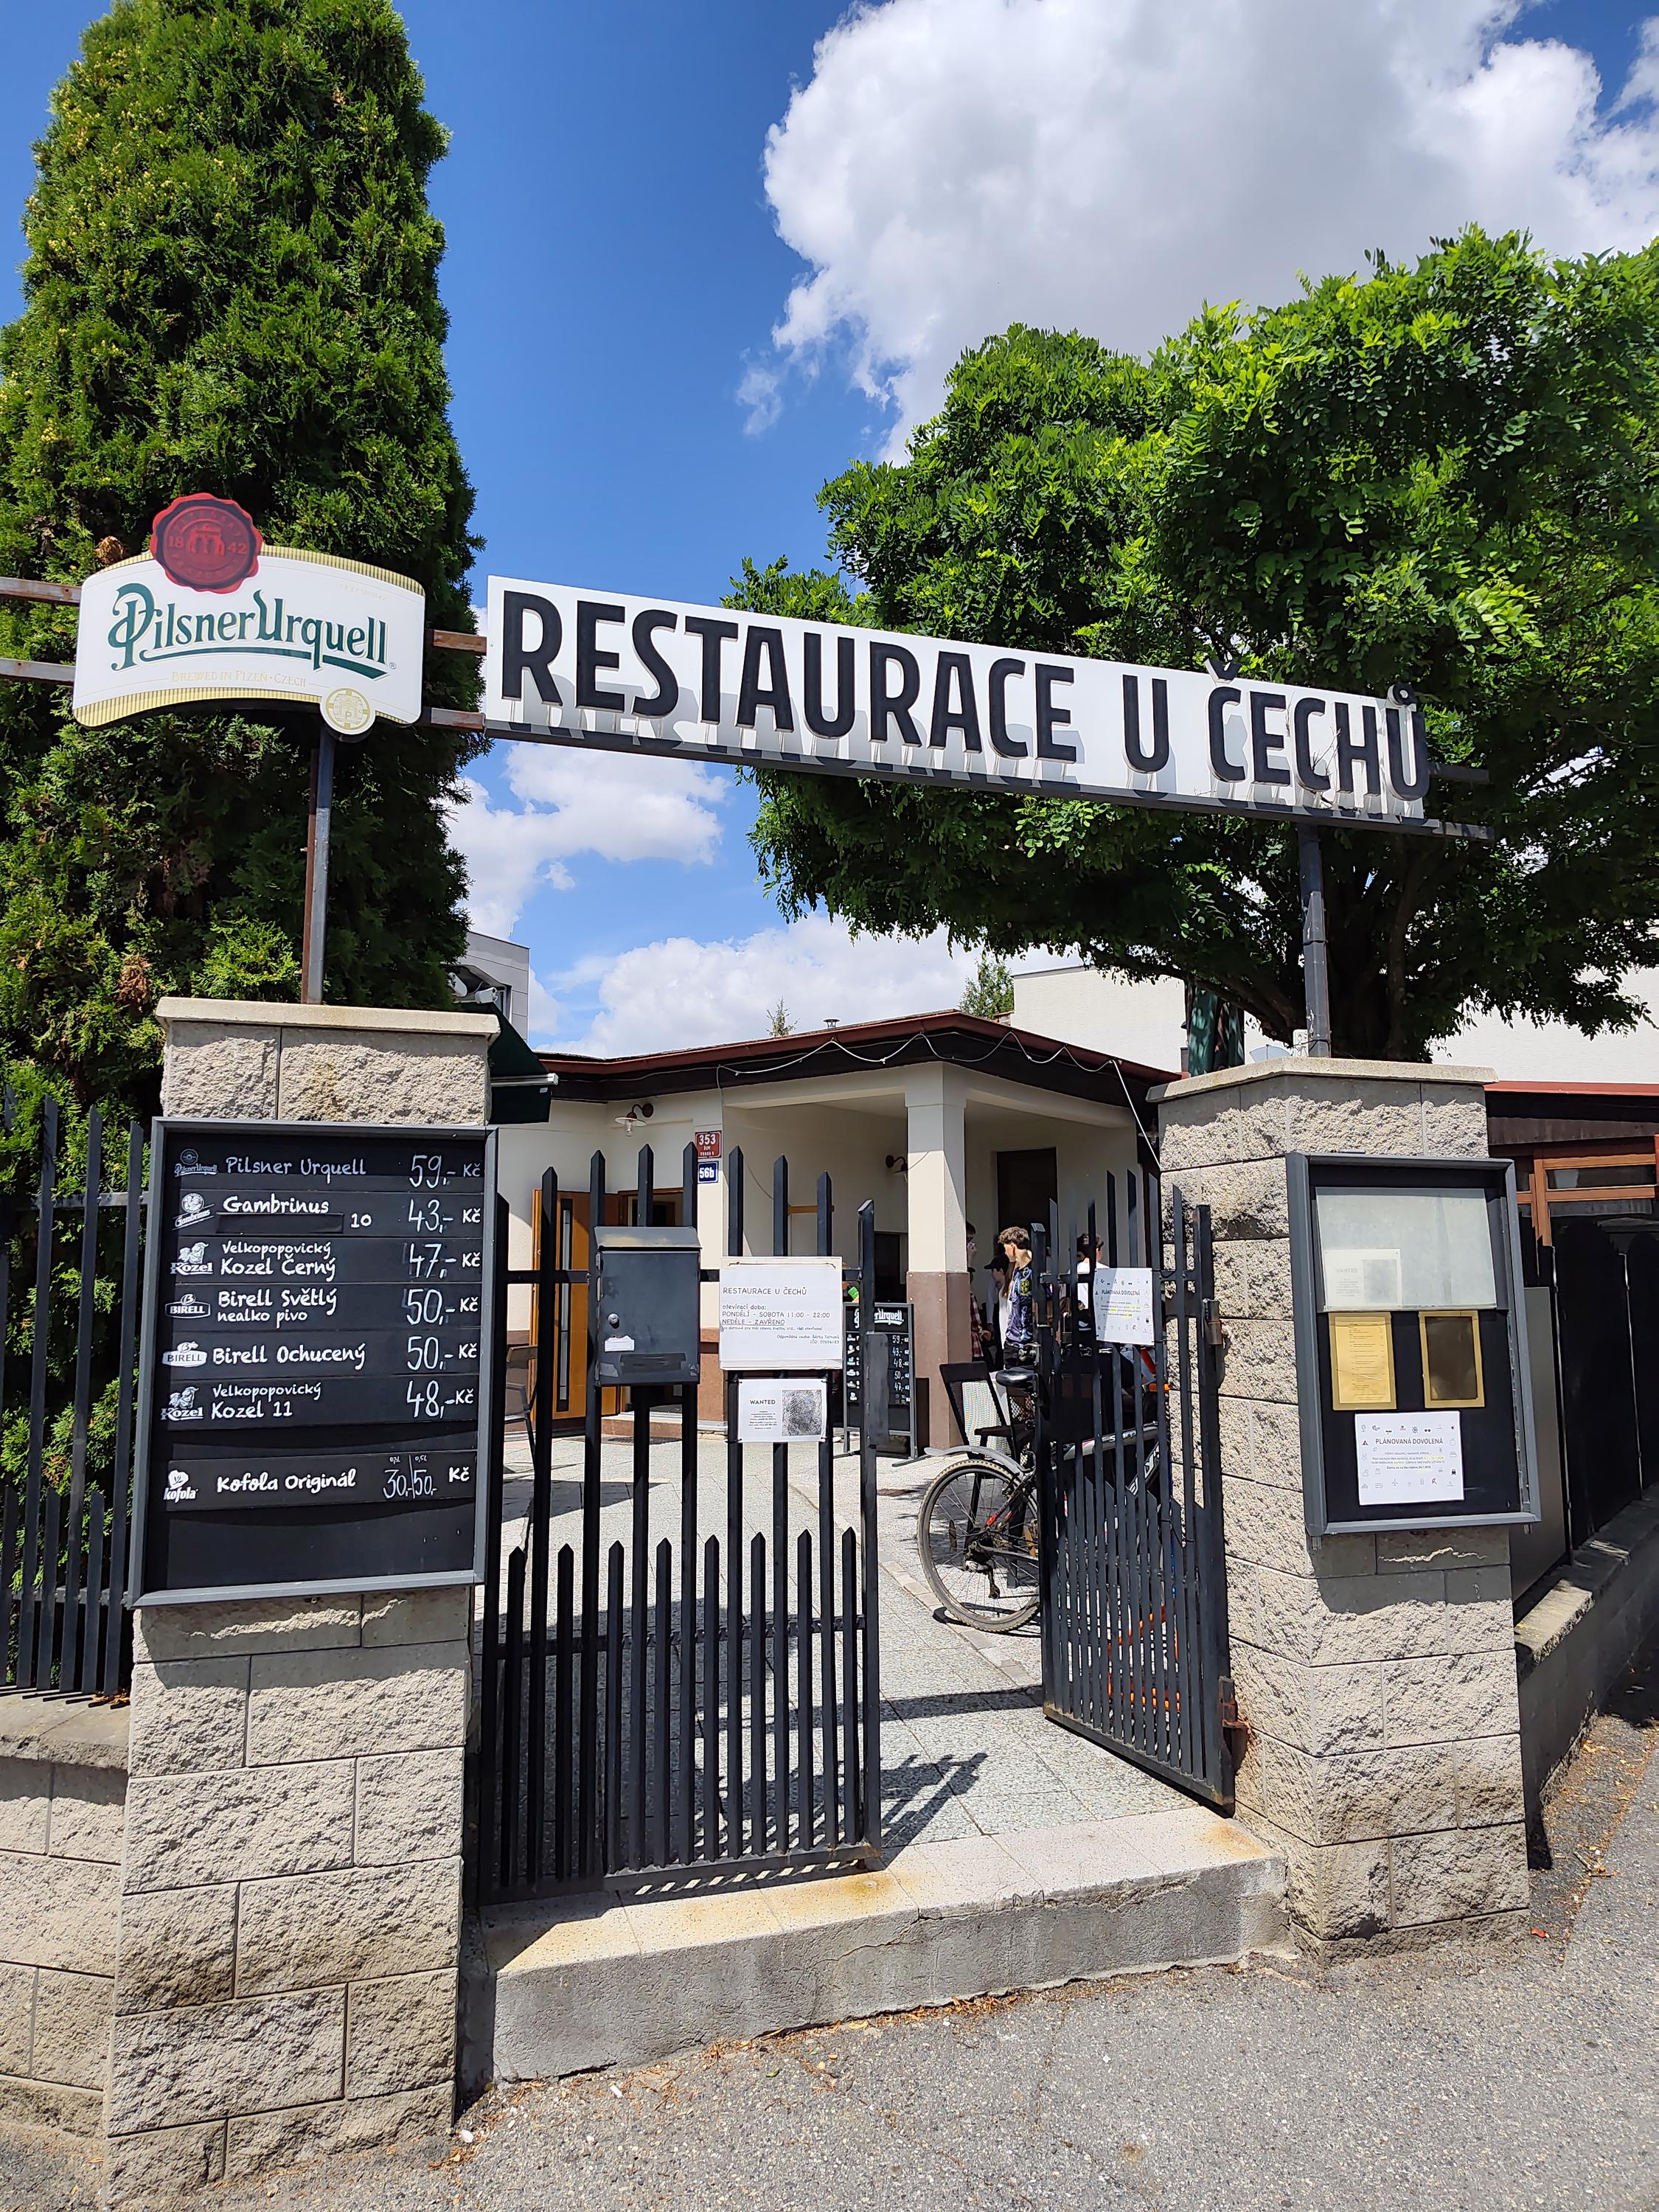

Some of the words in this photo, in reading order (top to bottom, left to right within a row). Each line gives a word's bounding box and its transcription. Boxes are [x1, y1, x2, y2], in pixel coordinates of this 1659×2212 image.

[254, 590, 388, 672] Urquell
[171, 671, 218, 683] BREWED
[220, 672, 232, 681] IN
[274, 672, 307, 688] CZECH
[502, 591, 1077, 764] RESTAURACE
[1122, 674, 1170, 776] U
[1204, 658, 1430, 801] ČECHŮ
[699, 1134, 716, 1145] 353
[225, 1156, 293, 1175] Pilsner
[300, 1158, 366, 1184] Urquell
[409, 1155, 456, 1189] 59,-
[463, 1163, 481, 1178] Kč
[699, 1167, 714, 1178] 56b
[223, 1193, 330, 1214] Gambrinus
[174, 1209, 211, 1228] Gambrinus
[350, 1213, 372, 1228] 10
[408, 1198, 454, 1234] 43,-
[462, 1208, 481, 1224] Kč
[222, 1239, 332, 1260] Velkopopovický
[462, 1252, 481, 1268] Kč
[170, 1262, 214, 1276] Kozel
[220, 1256, 274, 1276] Kozel
[282, 1253, 336, 1282] Černý
[218, 1288, 273, 1308] Birell
[281, 1287, 338, 1315] Světlý
[459, 1296, 479, 1312] Kč
[723, 1287, 772, 1295] RESTAURACE
[783, 1286, 807, 1295] ČECHŮ
[170, 1305, 206, 1315] BIRELL
[218, 1308, 271, 1323] nealko
[276, 1309, 308, 1329] pivo
[167, 1353, 203, 1363] BIRELL
[212, 1344, 268, 1364] Birell
[276, 1343, 366, 1371] Ochucený
[459, 1343, 478, 1359] Kč
[212, 1382, 321, 1402] Velkopopovický
[455, 1388, 474, 1405] Kč
[161, 1407, 204, 1422] Kozel
[211, 1399, 265, 1420] Kozel
[272, 1401, 293, 1417] 11
[1412, 1436, 1444, 1444] DOVOLENÁ
[216, 1471, 279, 1493] Kofola
[285, 1468, 357, 1495] Originál
[448, 1466, 470, 1483] Kč
[163, 1486, 198, 1503] kofola
